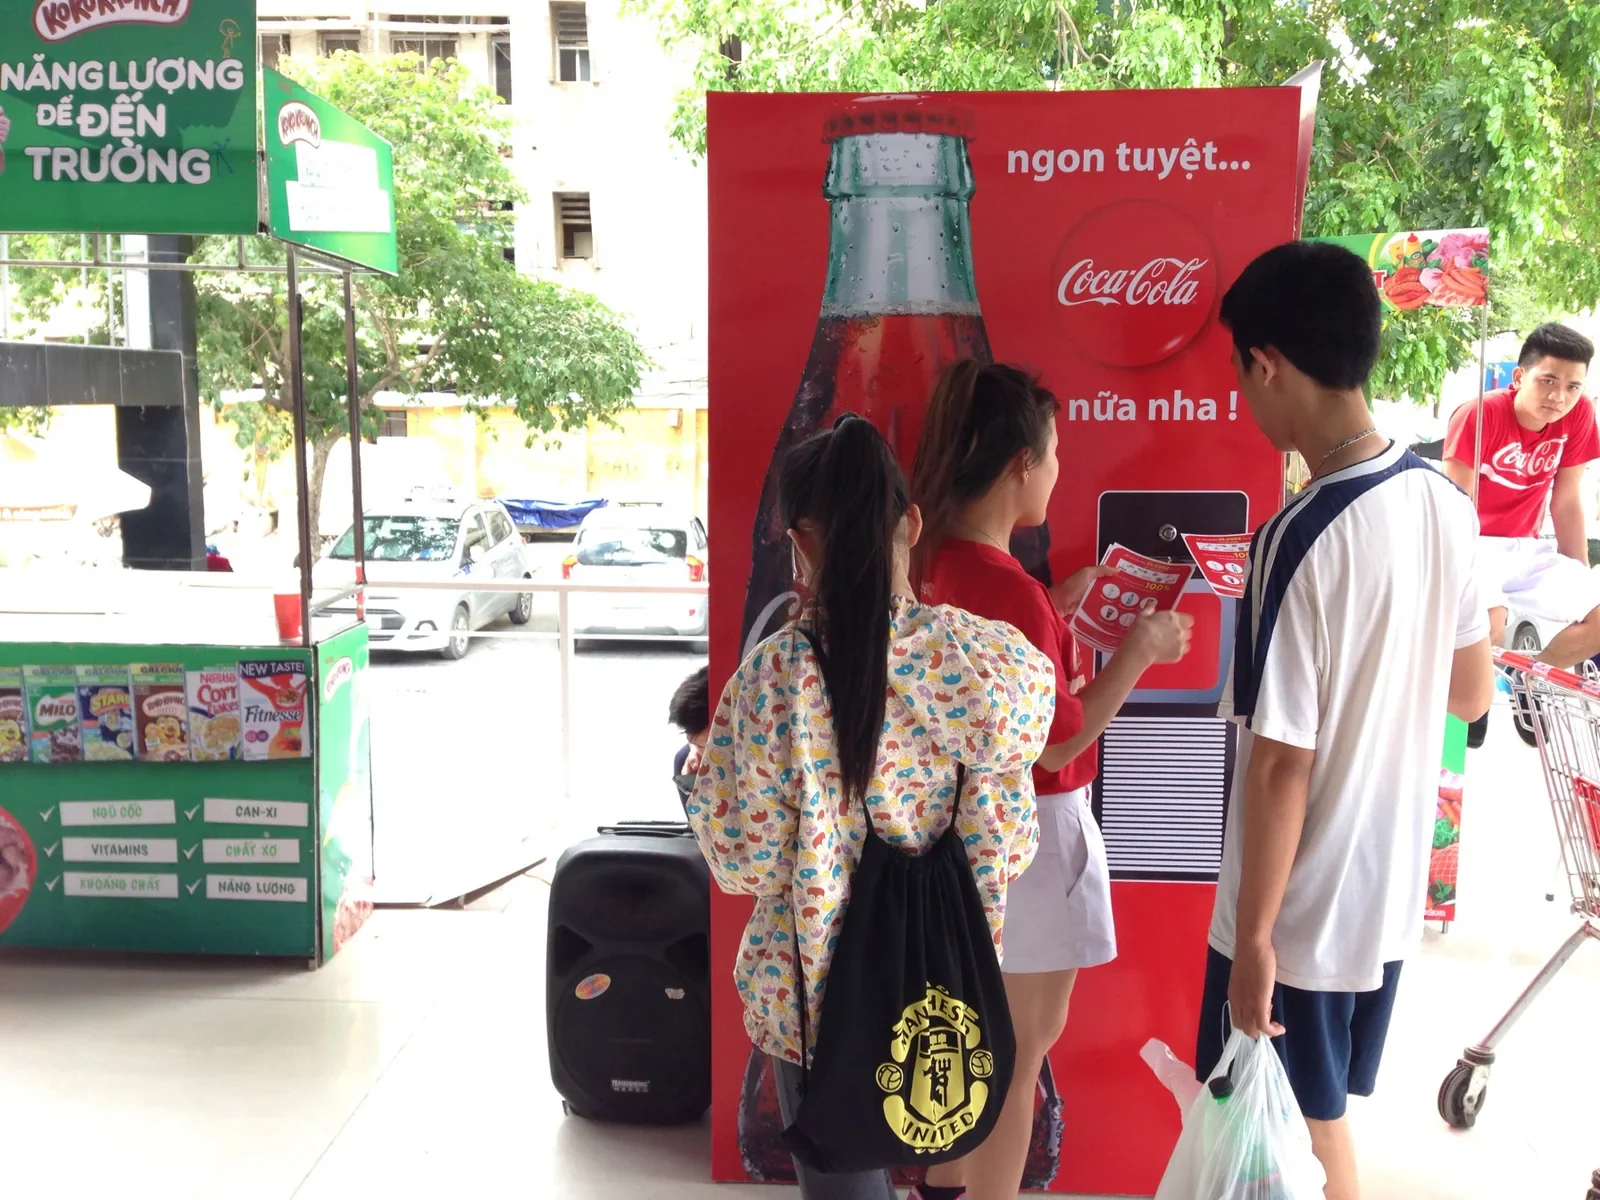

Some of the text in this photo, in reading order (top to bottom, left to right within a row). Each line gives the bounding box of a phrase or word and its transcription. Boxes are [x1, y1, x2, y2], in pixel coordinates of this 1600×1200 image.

[0, 53, 244, 95] NĂNG LƯỢNG
[75, 91, 166, 138] ĐẾN
[24, 136, 211, 184] TRƯỜNG
[1007, 137, 1250, 182] ngon tuyệt...
[1057, 258, 1209, 307] Coca-Cola
[1068, 390, 1136, 421] nữa
[1147, 389, 1217, 421] nha
[239, 661, 305, 676] NEW TASTE!
[39, 703, 76, 717] MILO
[244, 704, 302, 723] Fitnesse
[235, 805, 278, 819] CAN-XI
[91, 843, 149, 857] VITAMINS
[901, 1111, 974, 1144] UNITED
